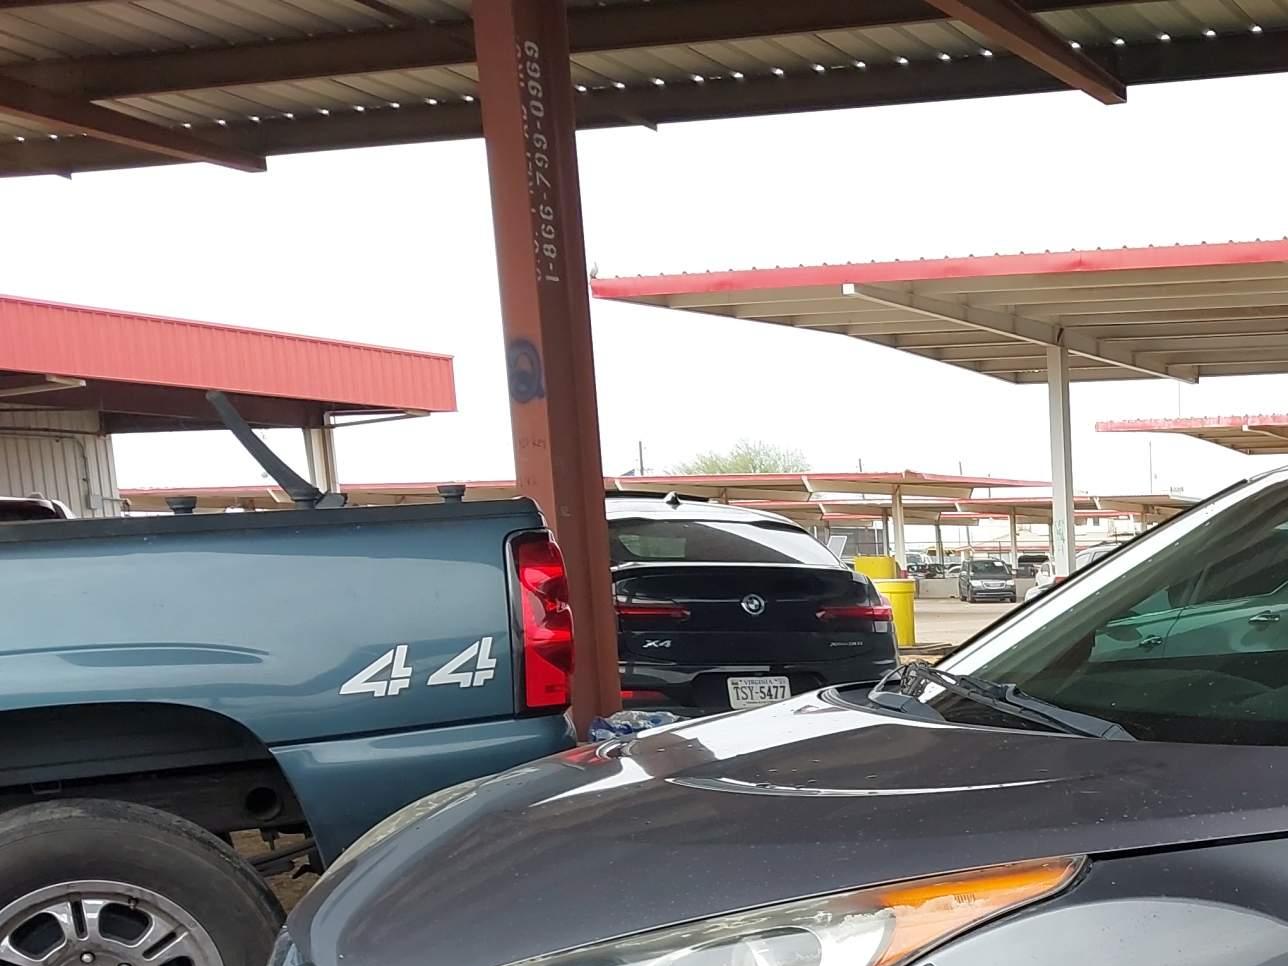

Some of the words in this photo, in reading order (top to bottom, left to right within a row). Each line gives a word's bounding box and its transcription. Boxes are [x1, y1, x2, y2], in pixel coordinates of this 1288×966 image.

[524, 40, 560, 282] 1-866-799-0969
[642, 639, 672, 648] X4
[338, 644, 413, 697] 4
[427, 636, 497, 688] 4
[733, 685, 786, 701] TSY-5477
